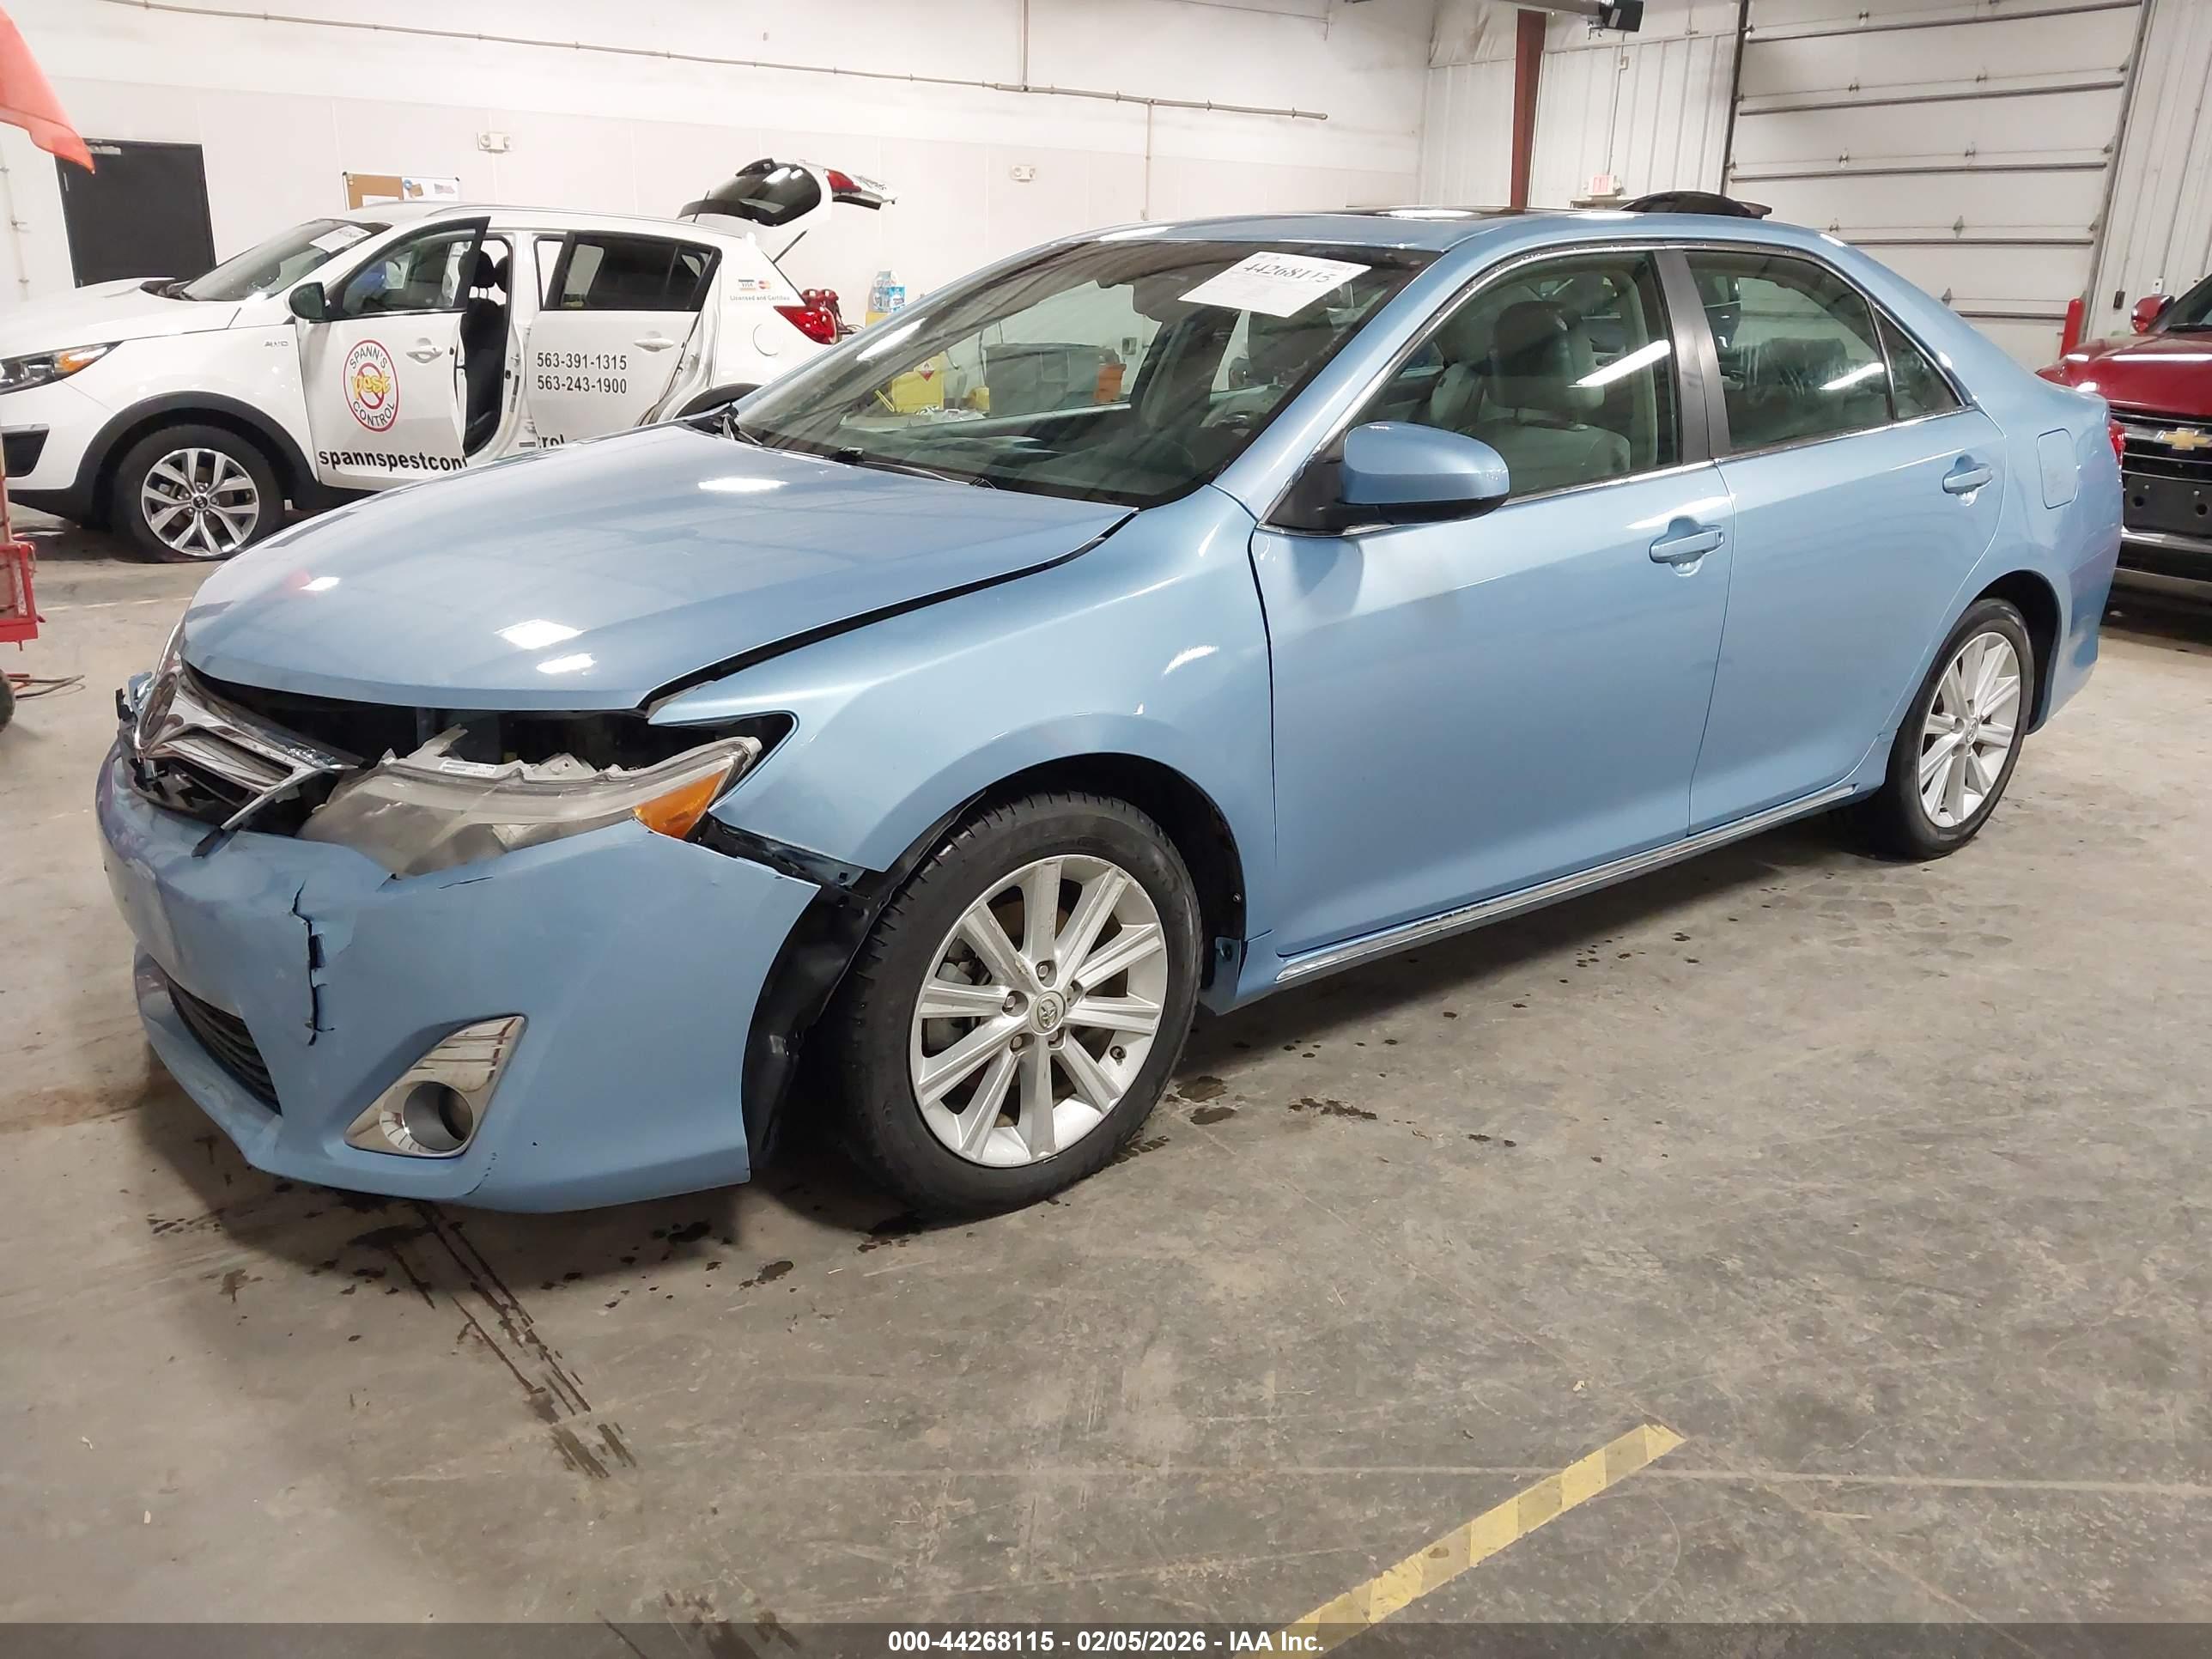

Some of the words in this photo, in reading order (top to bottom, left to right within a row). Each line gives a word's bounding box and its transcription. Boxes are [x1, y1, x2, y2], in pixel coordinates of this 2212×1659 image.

[1243, 263, 1338, 283] 44268115
[349, 345, 388, 369] SPANN'S
[537, 352, 627, 370] 563-391-1315
[350, 370, 392, 400] pest
[538, 375, 627, 394] 563-243-1900
[353, 401, 395, 427] CONTROL
